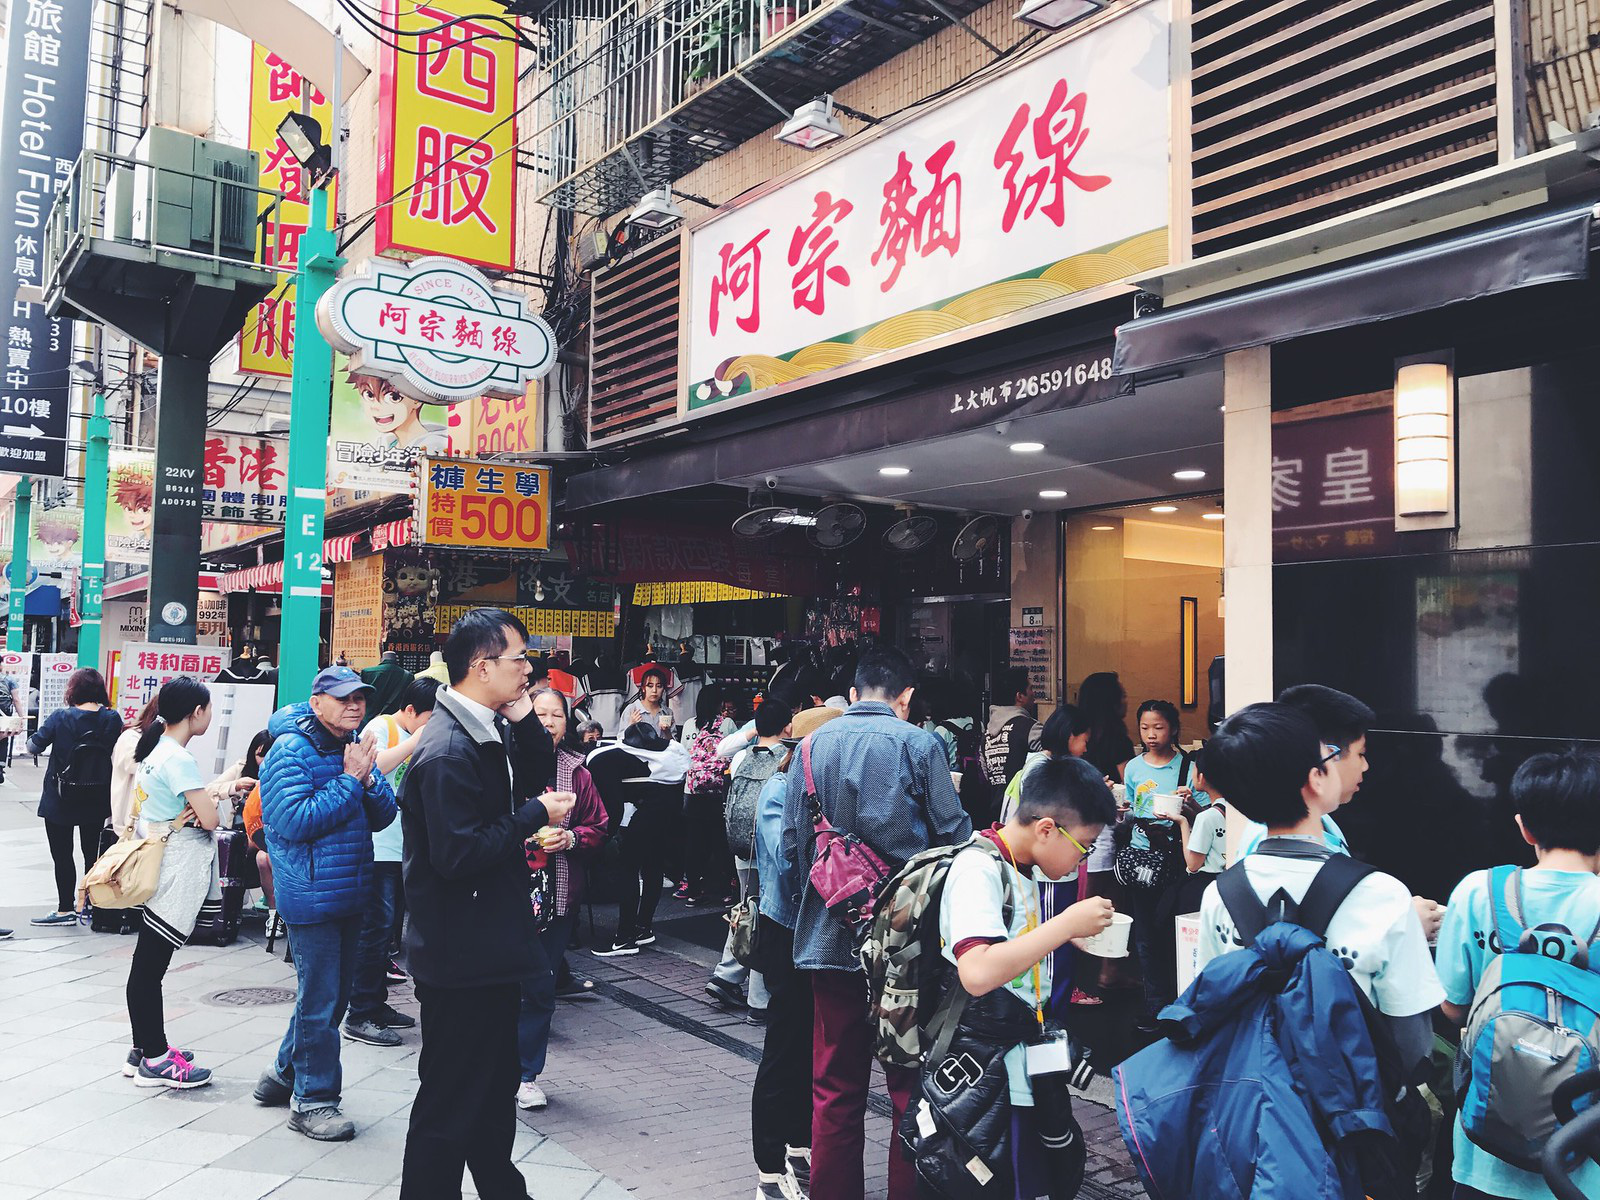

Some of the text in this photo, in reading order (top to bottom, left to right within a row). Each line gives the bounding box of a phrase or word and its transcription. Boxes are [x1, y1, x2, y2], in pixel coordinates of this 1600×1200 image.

[408, 4, 501, 235] 西服
[13, 73, 56, 228] Hotel Fun
[708, 77, 1112, 337] 阿宗麵線
[414, 278, 485, 308] SINCE 1975
[379, 302, 521, 357] 阿宗麵線
[6, 325, 32, 390] 熱賣中
[1015, 357, 1113, 400] 26591648
[1, 395, 51, 419] 10樓
[478, 416, 530, 453] ROCK
[165, 466, 195, 479] 22KV
[203, 437, 286, 491] 香港
[301, 513, 316, 537] E
[428, 492, 456, 539] 特價
[460, 494, 542, 542] 500
[294, 551, 321, 573] 12
[89, 576, 99, 588] E
[14, 598, 22, 608] E
[84, 593, 103, 605] 10
[10, 613, 24, 622] 08
[138, 651, 222, 674] 特約商店
